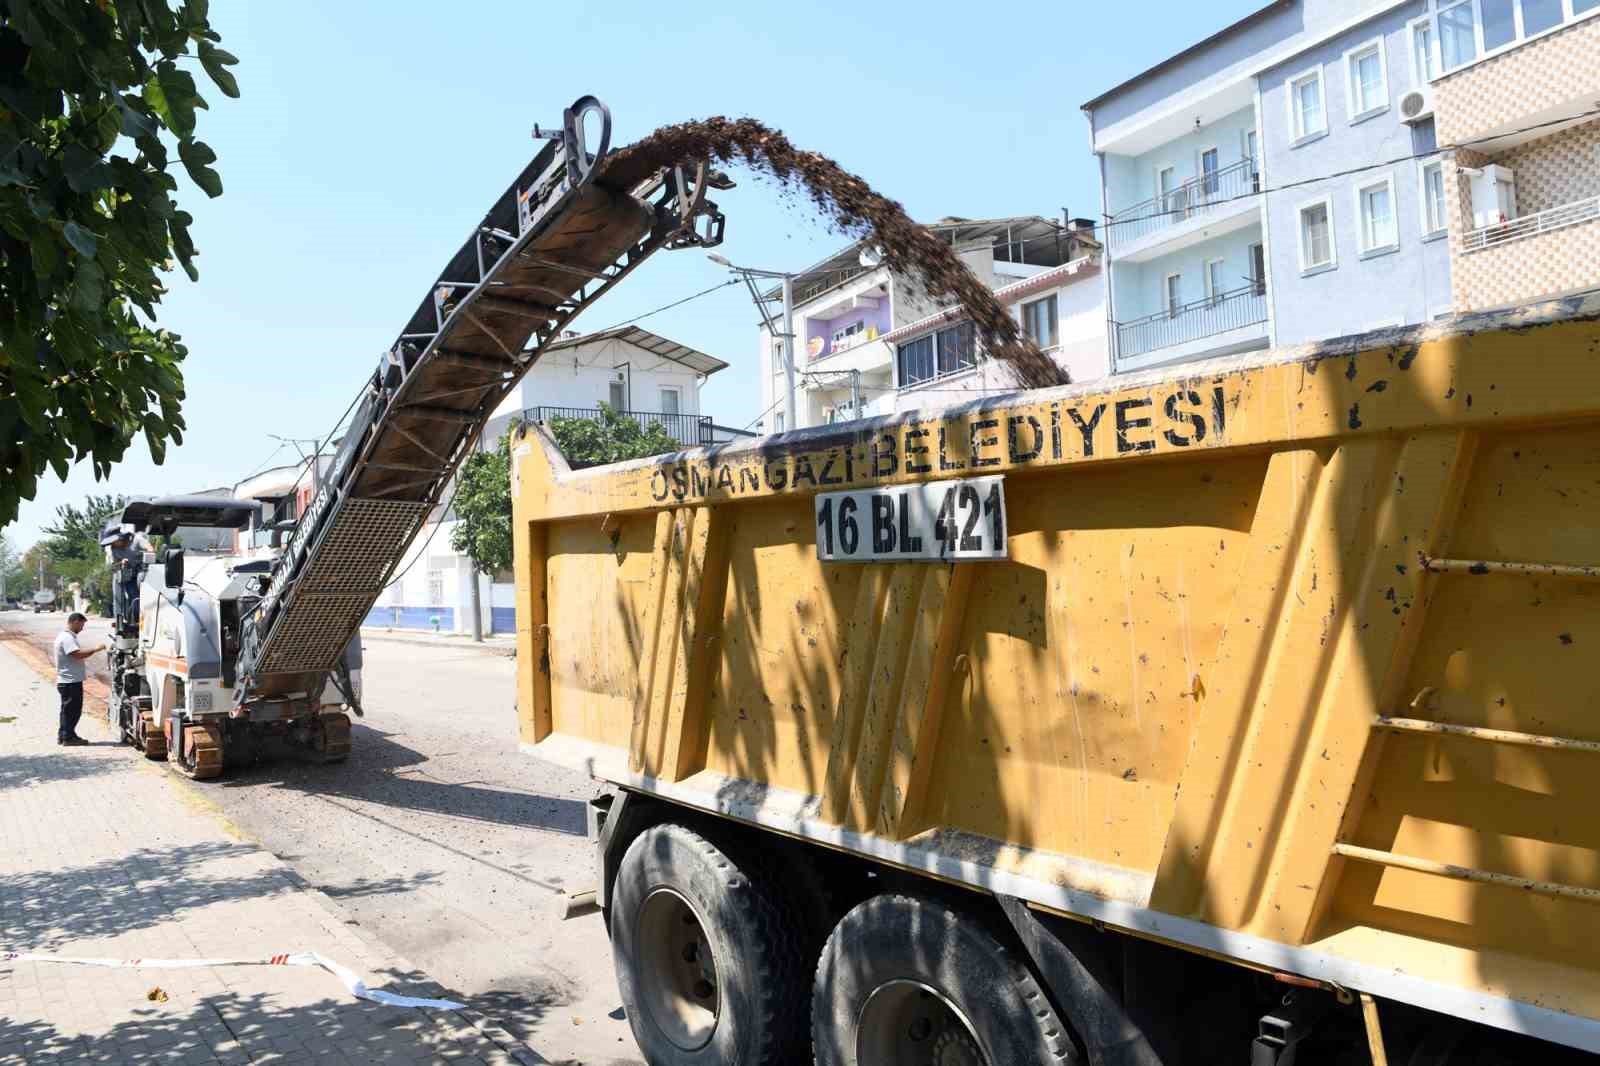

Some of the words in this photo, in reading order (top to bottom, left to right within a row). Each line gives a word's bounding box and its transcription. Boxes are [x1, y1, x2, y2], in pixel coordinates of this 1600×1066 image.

[651, 443, 854, 504] OSMANGAZİ
[872, 379, 1226, 478] BELEDİYESİ
[818, 496, 859, 555] 16
[872, 493, 922, 553] BL
[936, 483, 1004, 555] 421
